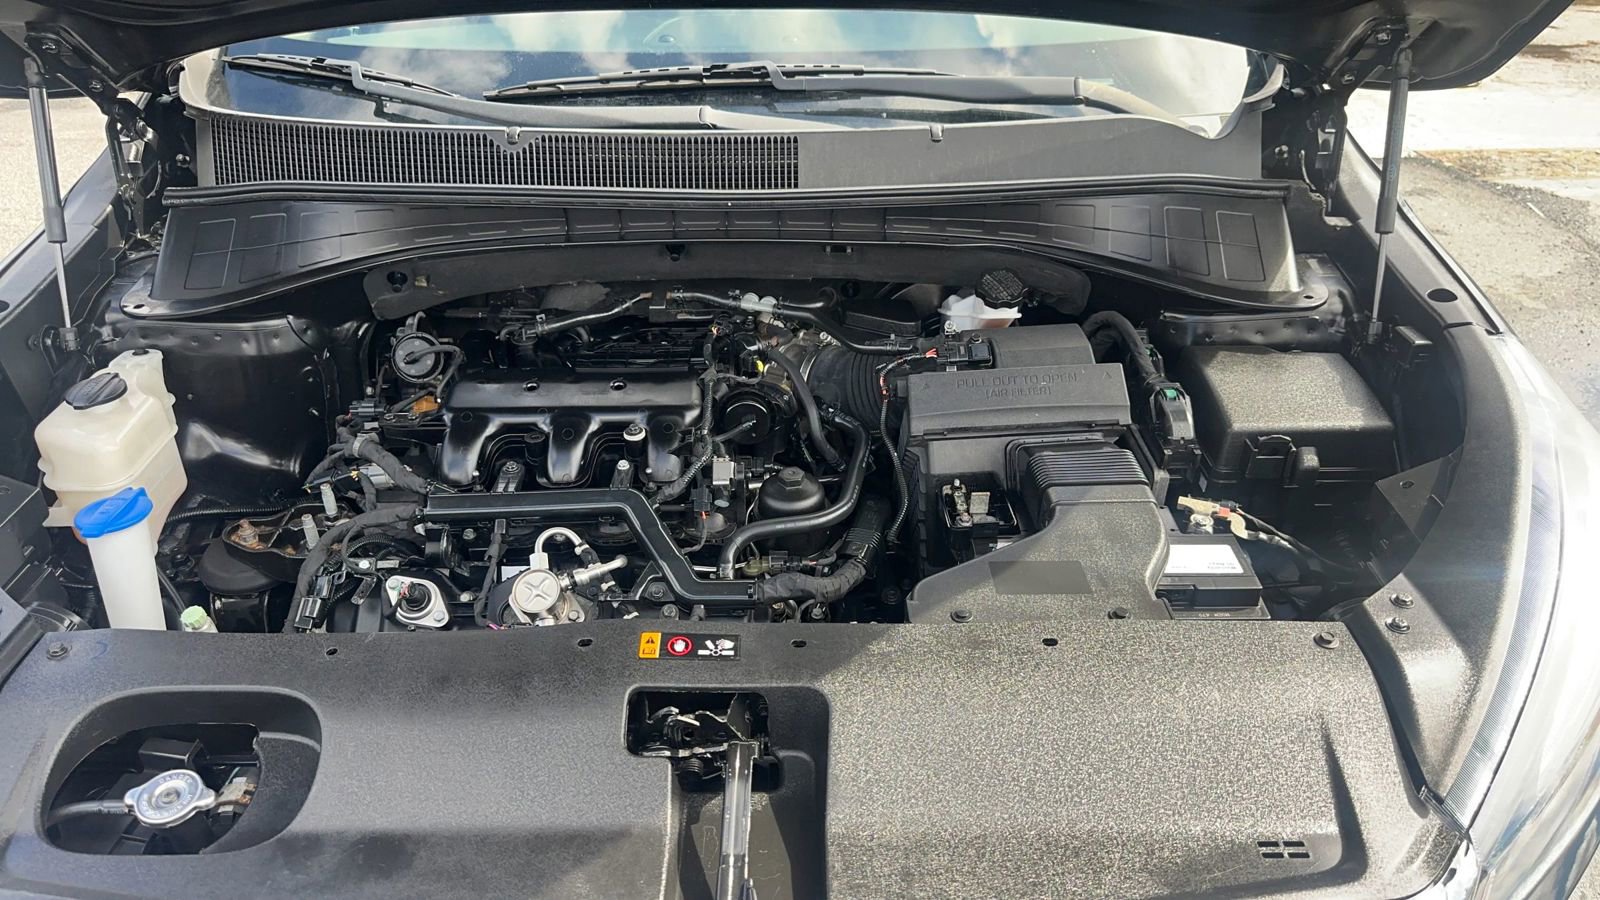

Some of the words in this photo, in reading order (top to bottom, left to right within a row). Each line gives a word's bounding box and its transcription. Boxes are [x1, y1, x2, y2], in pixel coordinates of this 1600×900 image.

[956, 377, 987, 388] PULL
[992, 375, 1019, 386] OUT
[1022, 374, 1039, 385] TO
[1041, 372, 1077, 384] OPEN
[985, 387, 1008, 399] (AIR
[1011, 385, 1052, 397] FILTER)
